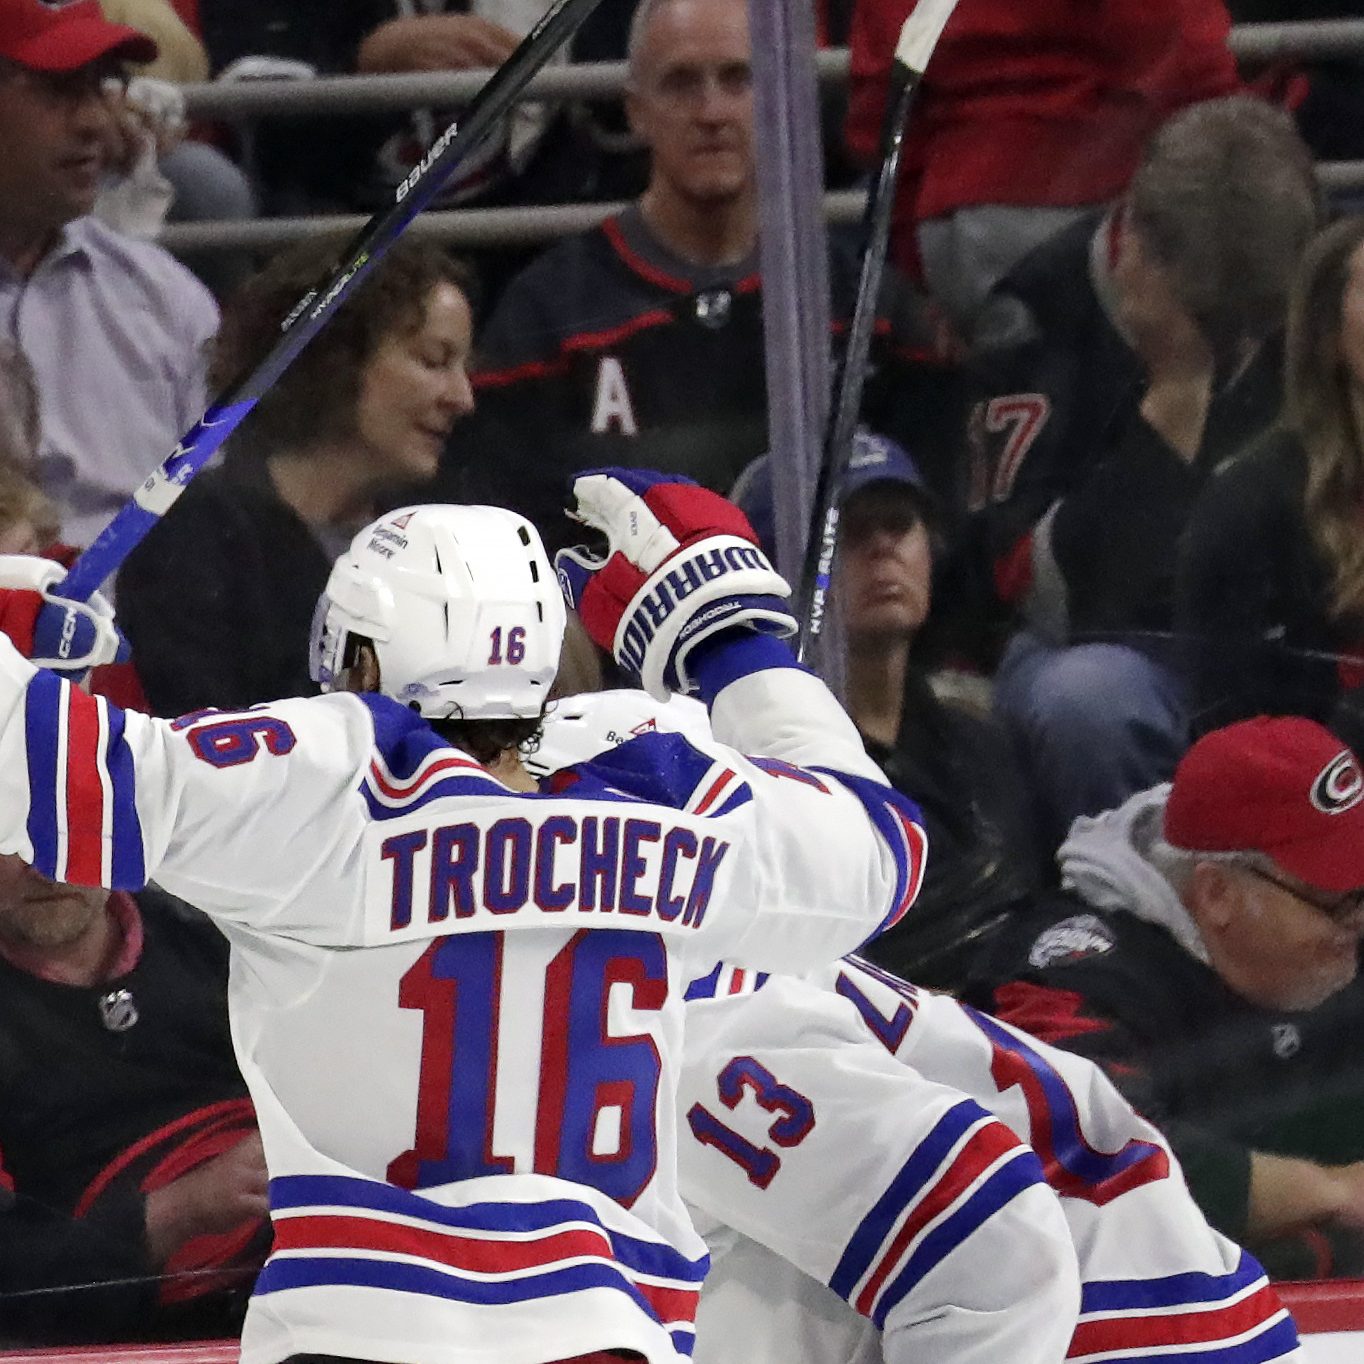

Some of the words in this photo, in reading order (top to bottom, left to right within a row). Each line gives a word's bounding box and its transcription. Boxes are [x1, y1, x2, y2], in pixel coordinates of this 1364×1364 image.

[396, 122, 458, 204] BAUER
[590, 356, 637, 435] A
[486, 626, 527, 665] 16
[380, 816, 730, 932] TROCHECK
[385, 928, 669, 1210] 16
[686, 1055, 817, 1191] 13
